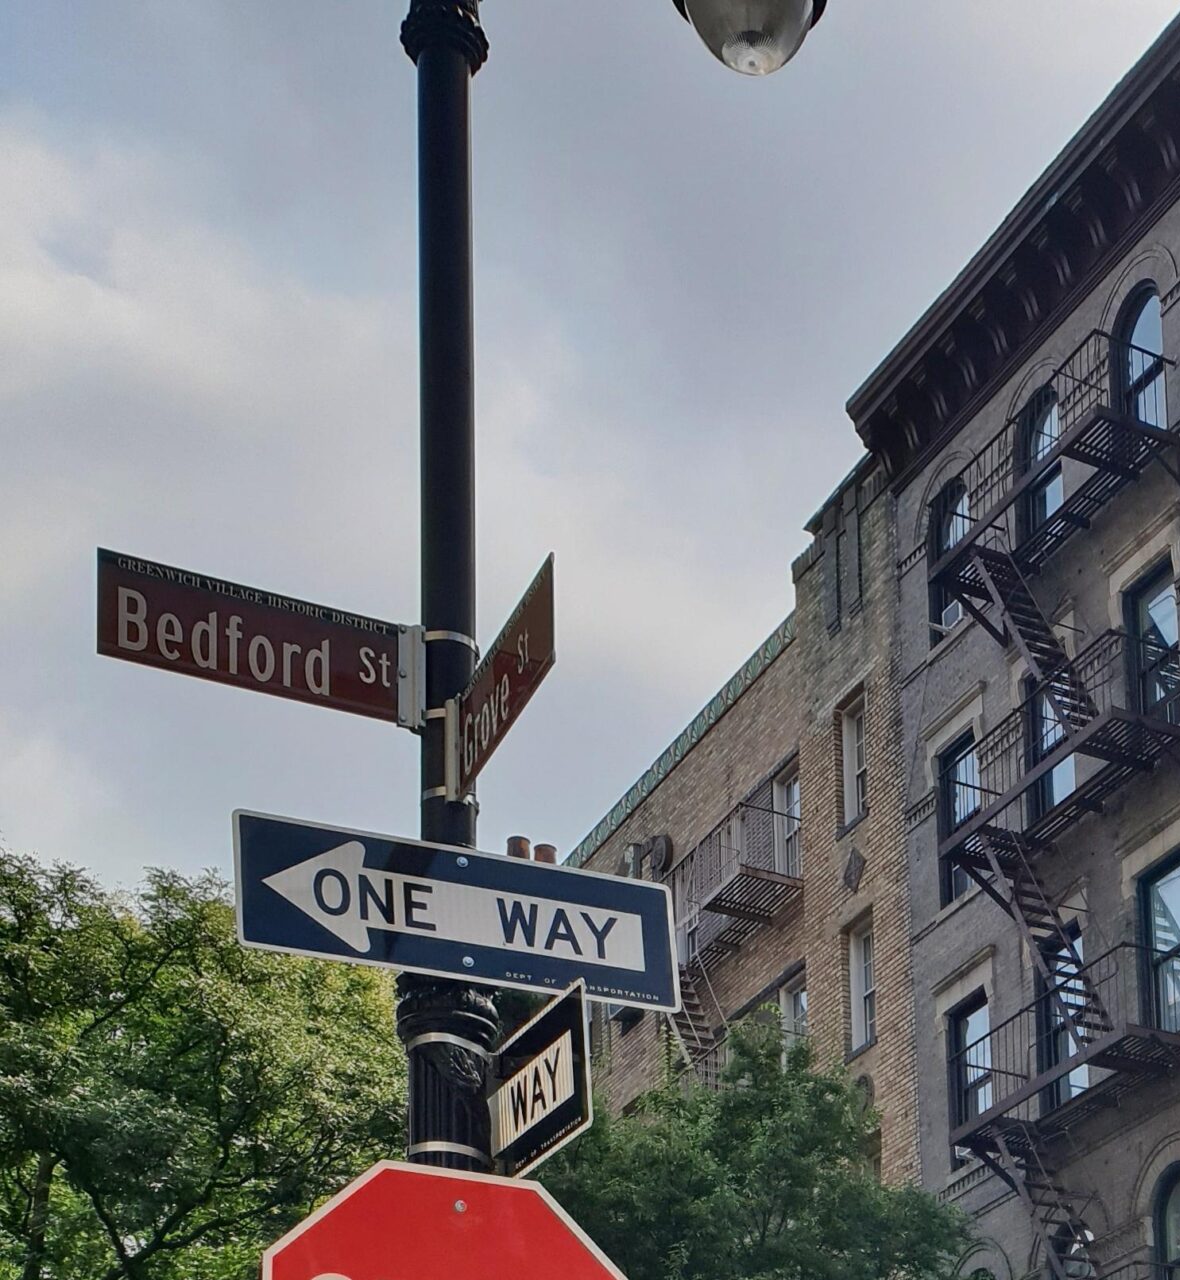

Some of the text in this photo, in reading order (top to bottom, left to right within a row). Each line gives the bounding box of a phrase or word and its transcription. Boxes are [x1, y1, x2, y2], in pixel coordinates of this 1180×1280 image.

[118, 557, 390, 635] GREENWICH VILLAGE HISTORIC DISTRICT
[118, 586, 391, 697] Bedford St
[464, 628, 529, 776] Grove St
[313, 868, 618, 960] ONE WAY
[505, 971, 660, 1001] DEPT OF NSPORTATION
[510, 1047, 561, 1132] WAY
